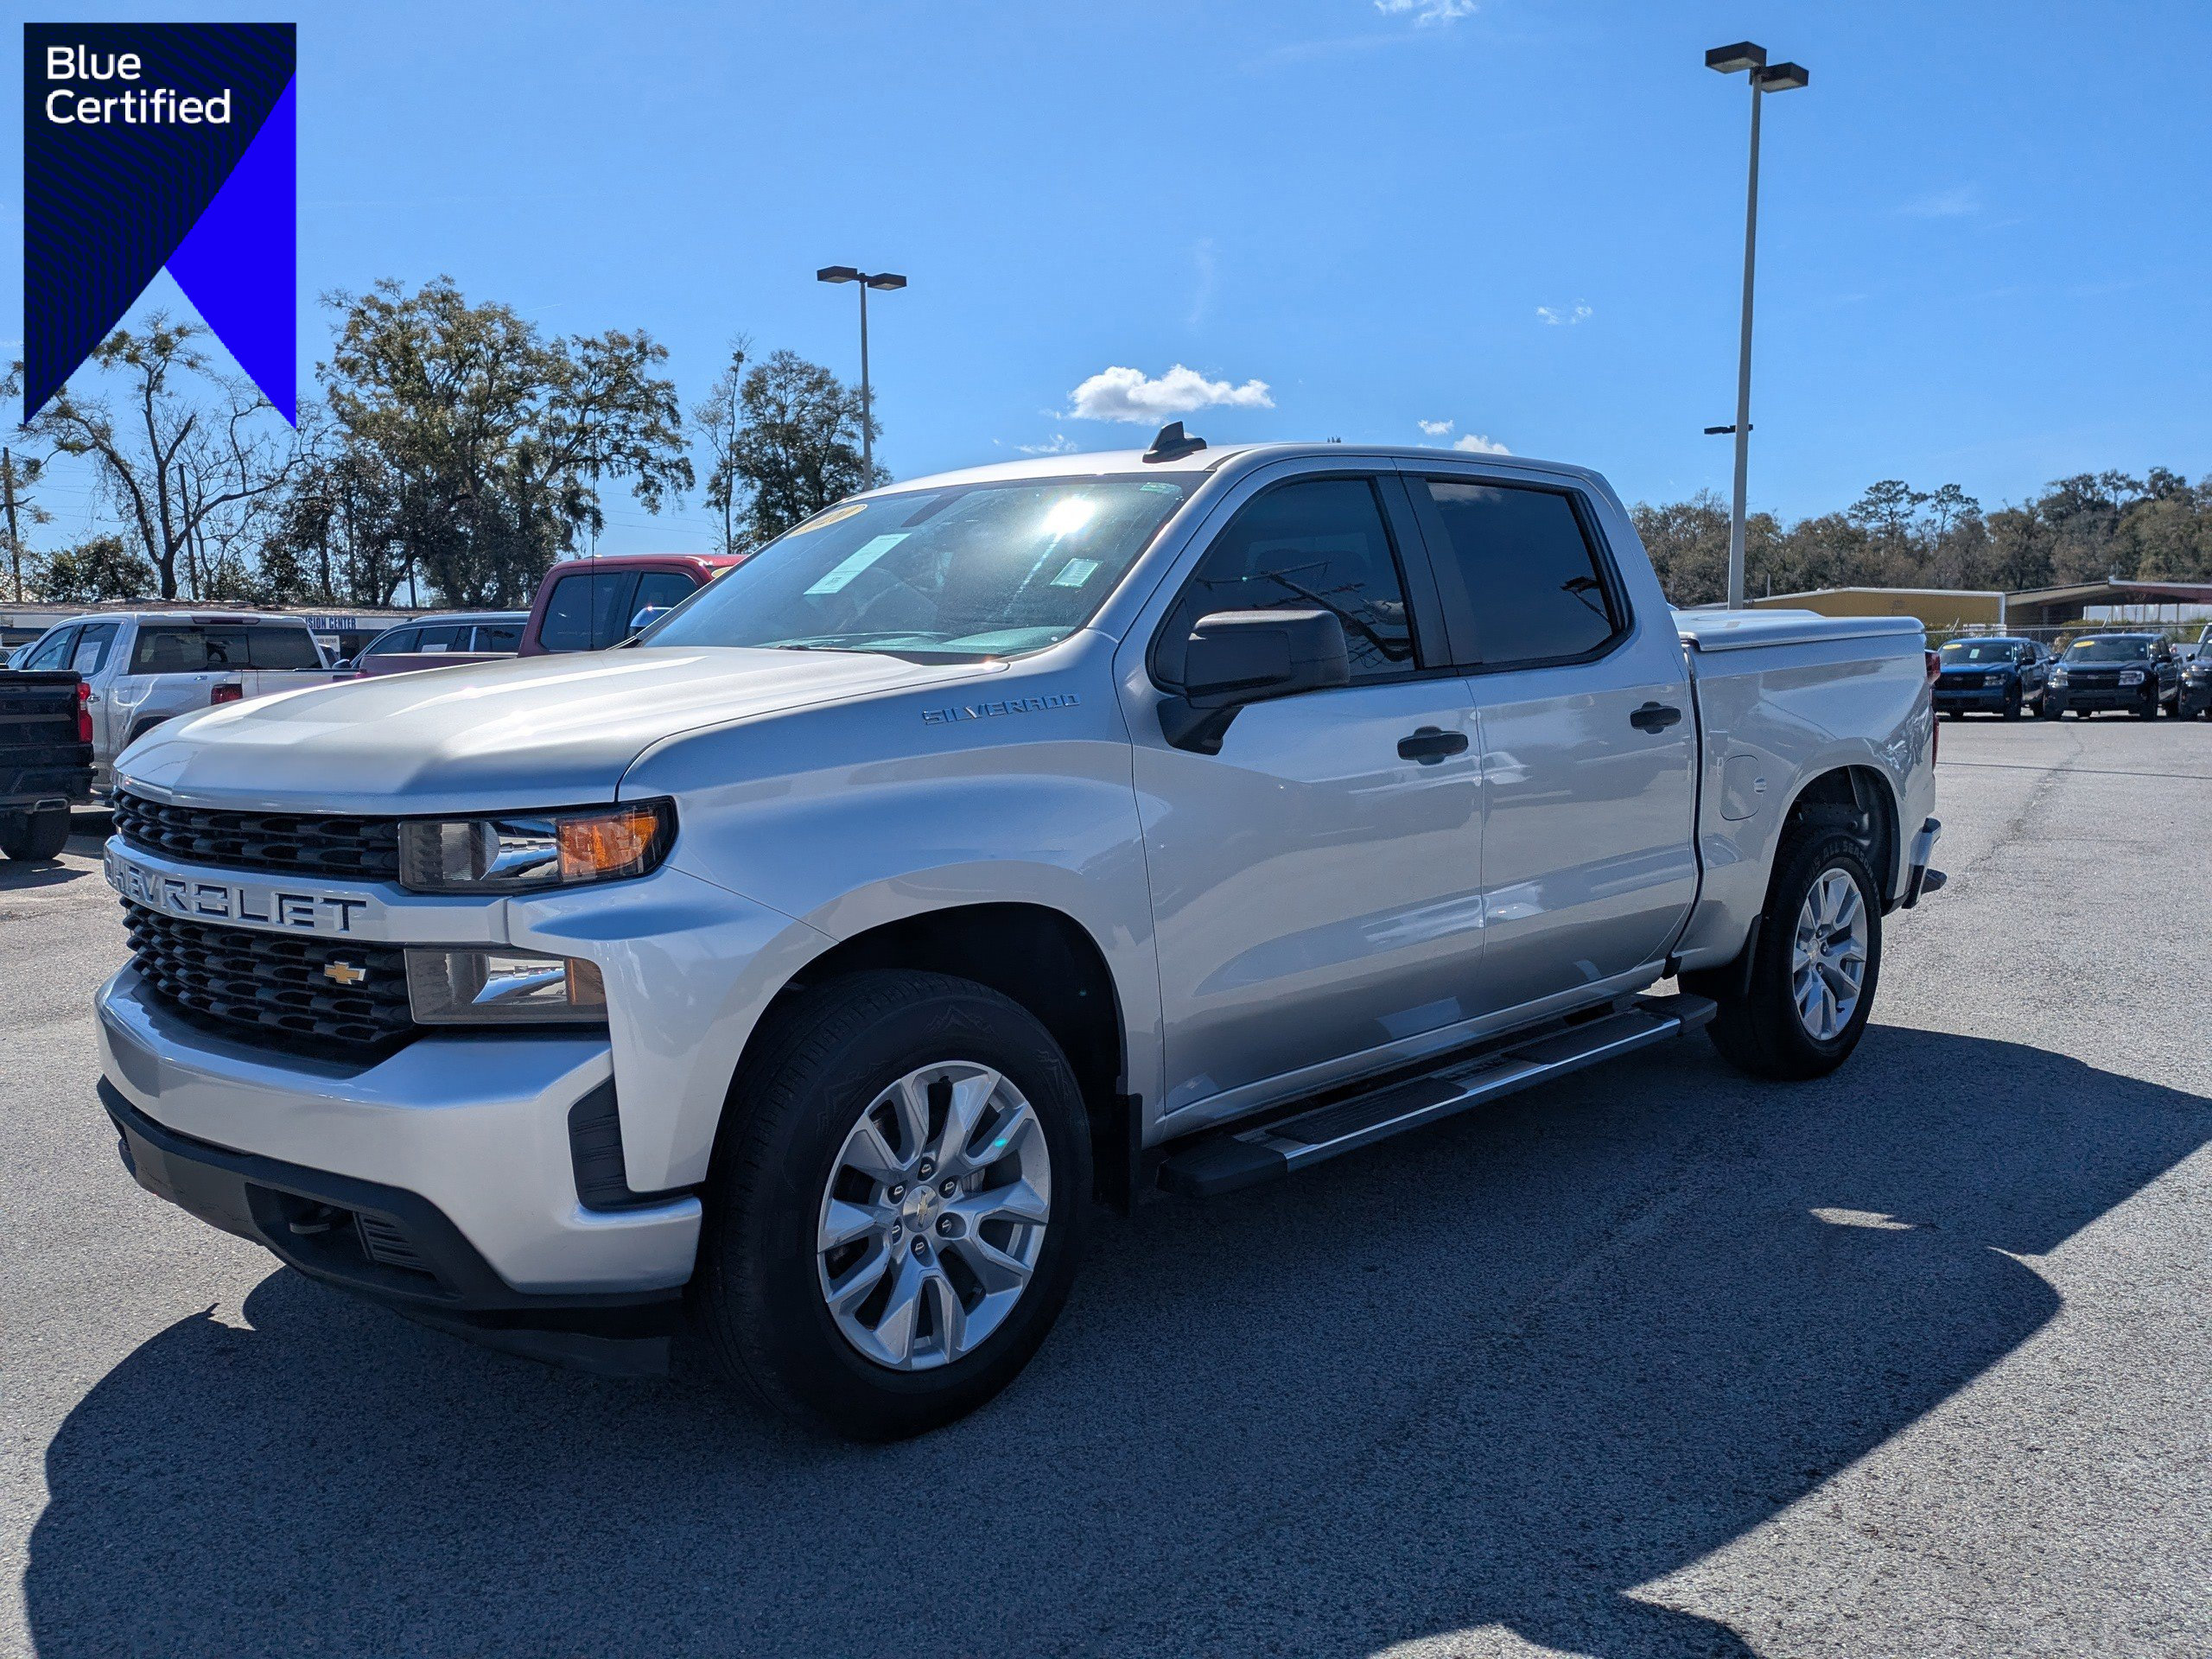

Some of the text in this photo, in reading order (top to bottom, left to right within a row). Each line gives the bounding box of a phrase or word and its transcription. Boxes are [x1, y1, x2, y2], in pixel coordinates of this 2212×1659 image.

[329, 617, 356, 629] CENTER
[922, 695, 1081, 725] SILVERADO
[105, 854, 367, 931] CHEVROLET
